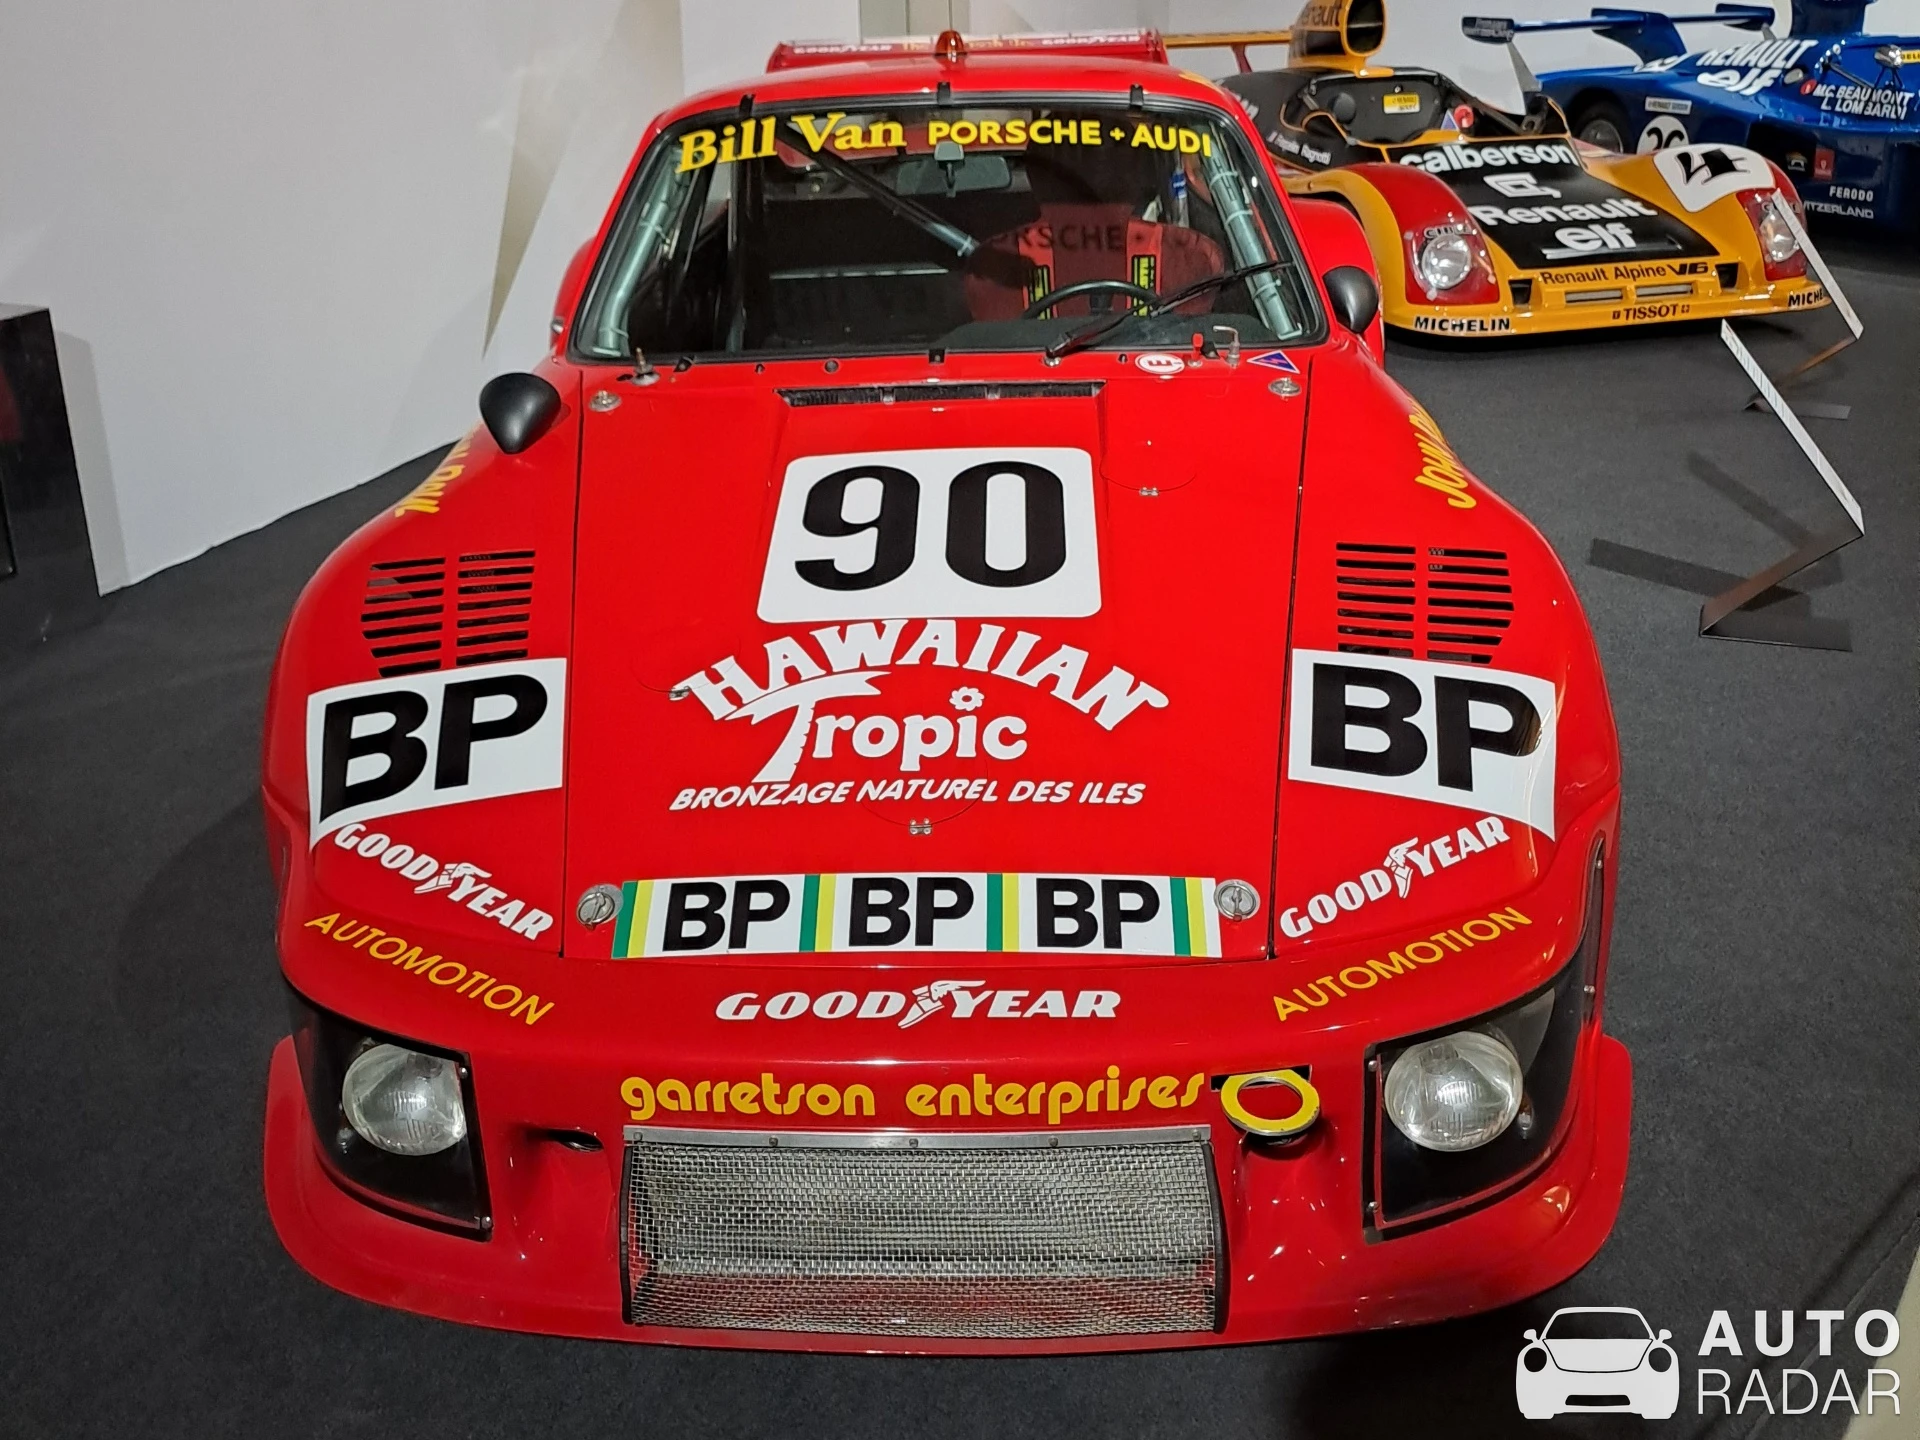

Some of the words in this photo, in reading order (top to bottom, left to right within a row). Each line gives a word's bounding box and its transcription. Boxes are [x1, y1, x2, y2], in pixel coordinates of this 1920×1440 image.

[1696, 68, 1783, 97] elf
[676, 116, 776, 173] Bill
[791, 112, 907, 153] Van
[928, 119, 1102, 147] PORSCHE
[1131, 123, 1212, 158] AUDI
[1400, 142, 1579, 174] calberson
[1467, 198, 1658, 226] Renault
[1803, 201, 1874, 219] ITZERLAND
[1829, 185, 1874, 202] FERODO
[1555, 222, 1638, 251] elf
[1539, 266, 1609, 285] Renault
[1613, 264, 1666, 282] Alpine
[1667, 262, 1708, 276] V6
[1414, 315, 1511, 333] MICHELIN
[1623, 304, 1679, 320] TISSOT
[795, 461, 1067, 591] 90
[670, 619, 1169, 732] HAWAIIAN
[319, 673, 548, 825] BP
[724, 671, 1028, 783] Tropic
[1310, 662, 1541, 792] BP
[670, 779, 855, 811] BRONZAGE
[857, 778, 998, 803] NATUREL
[1008, 781, 1071, 804] DES
[1079, 782, 1146, 805] ILES
[662, 880, 791, 952] BP
[848, 877, 974, 947] BP
[1036, 877, 1160, 949] BP
[304, 912, 555, 1026] AUTOMOTION
[1273, 906, 1533, 1022] AUTOMOTION
[621, 1074, 876, 1121] garretson
[905, 1065, 1204, 1125] enterprises
